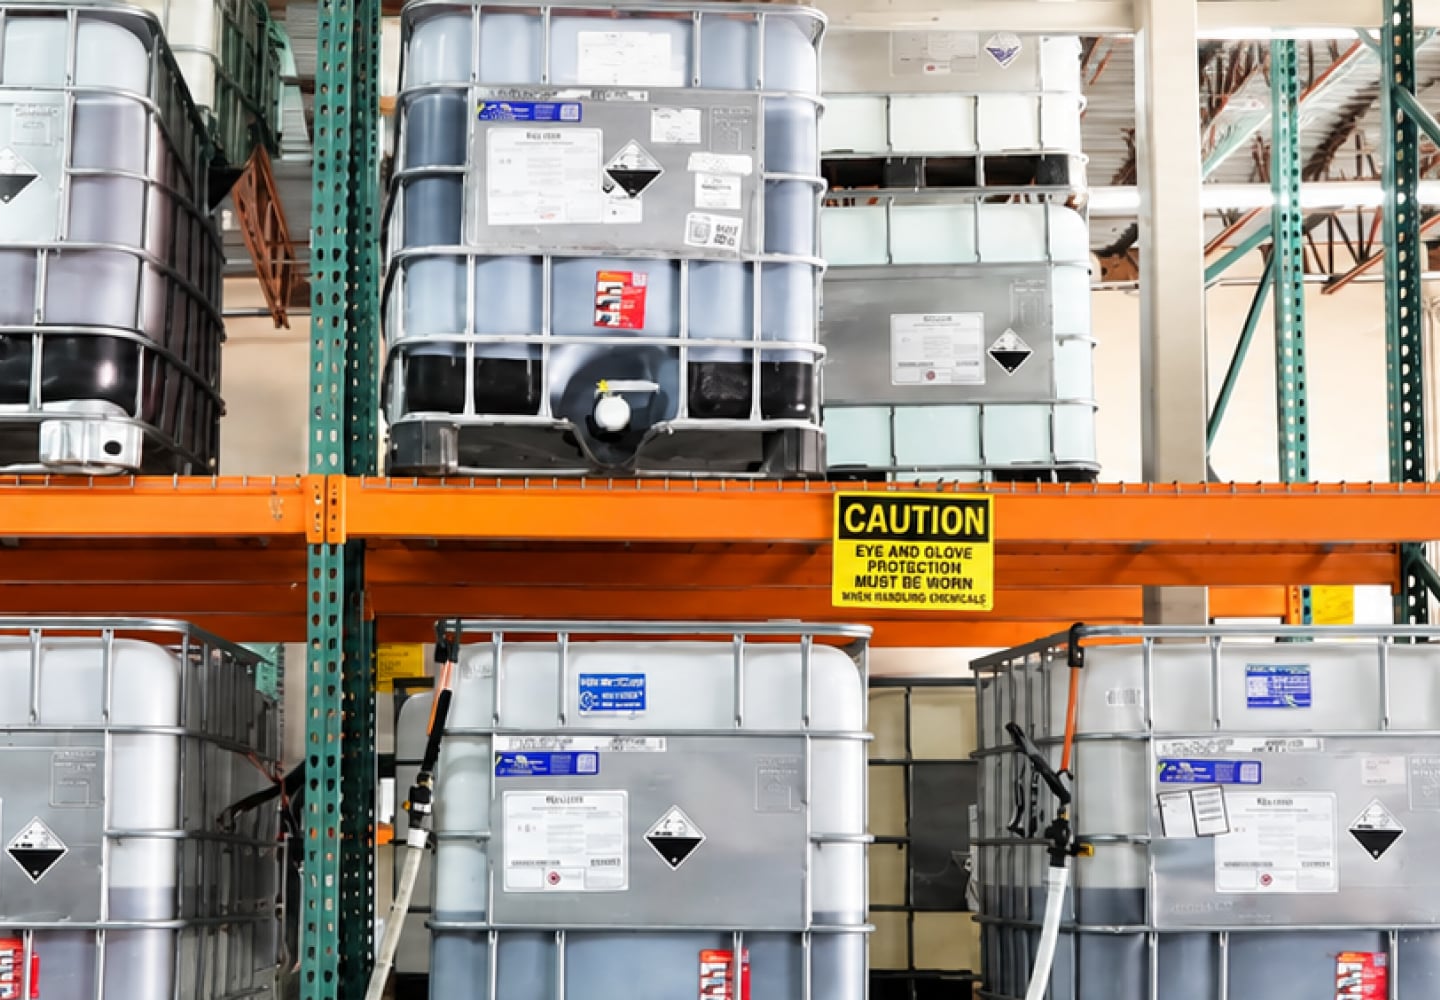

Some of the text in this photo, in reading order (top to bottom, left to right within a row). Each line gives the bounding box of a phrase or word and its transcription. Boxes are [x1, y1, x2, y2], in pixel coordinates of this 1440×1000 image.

[843, 502, 985, 536] CAUTION
[855, 544, 884, 558] EYE
[888, 545, 920, 559] AND
[867, 560, 962, 574] PROTECTION
[854, 575, 973, 590] MUST BE WORN
